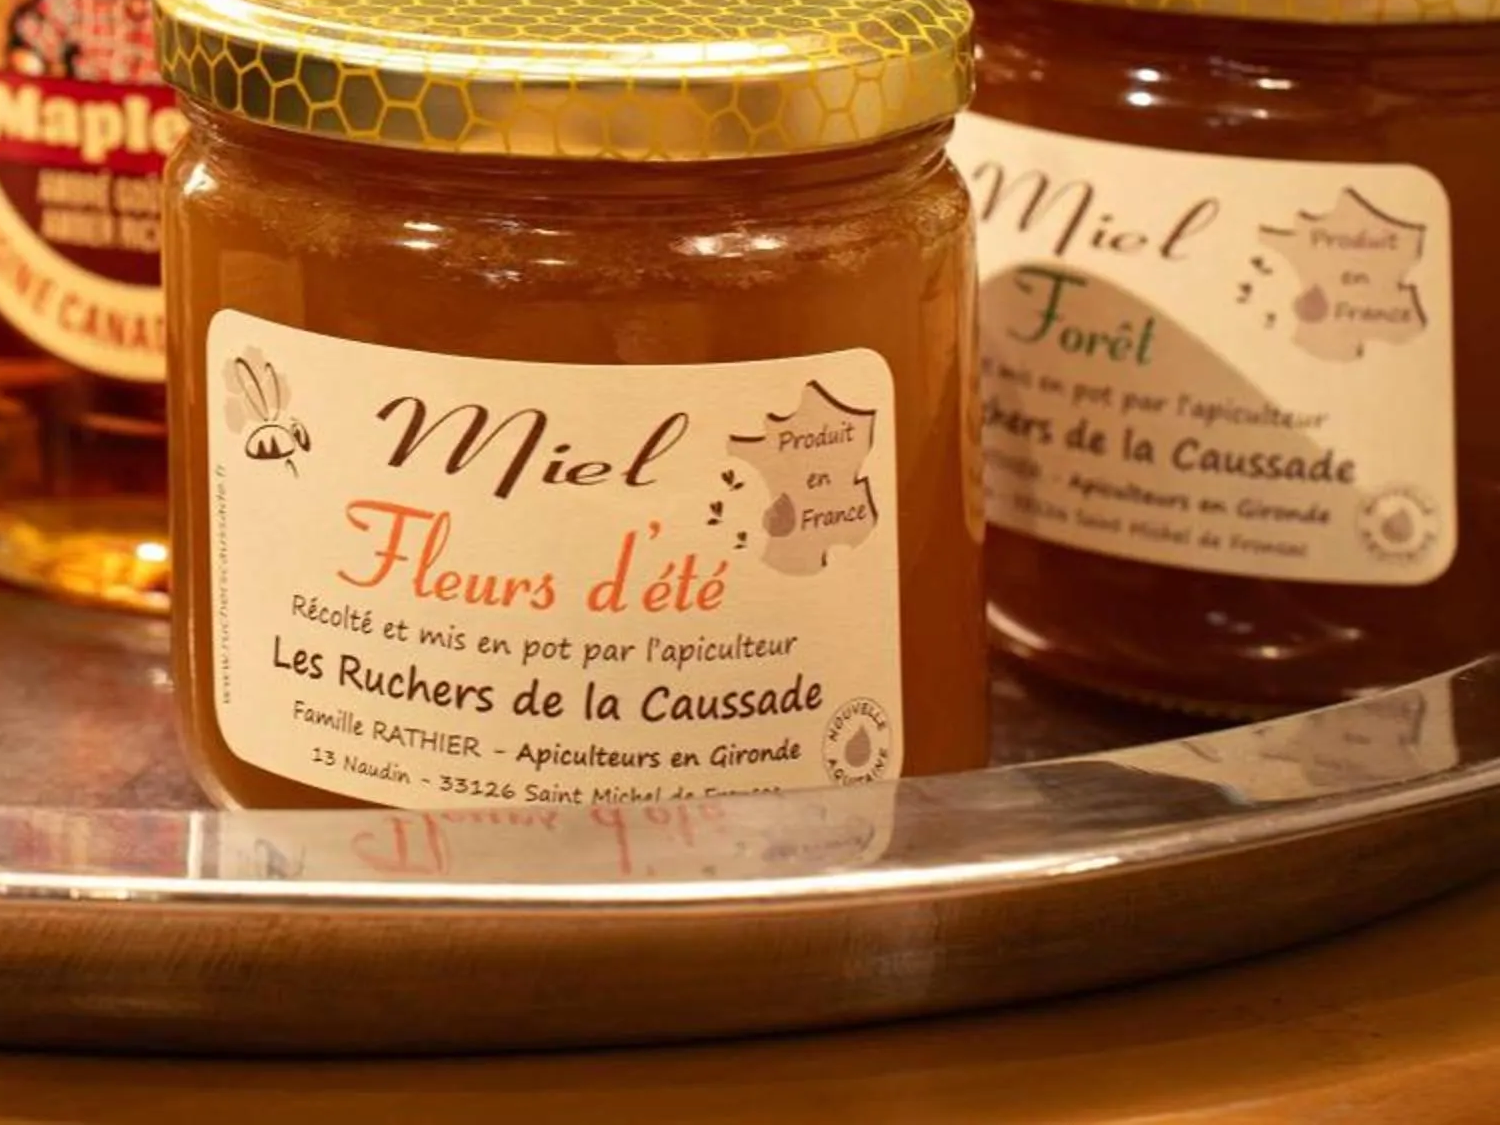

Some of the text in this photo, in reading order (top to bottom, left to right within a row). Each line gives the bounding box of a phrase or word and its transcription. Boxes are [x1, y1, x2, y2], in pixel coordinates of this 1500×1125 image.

[971, 161, 1220, 261] Miel
[1310, 228, 1398, 252] Produit
[1008, 264, 1157, 366] Forêt
[1334, 301, 1412, 324] France
[376, 396, 689, 499] Miel
[778, 421, 856, 451] Produit
[1065, 418, 1106, 456] de
[1123, 427, 1155, 464] la
[1171, 437, 1356, 484] Caussade
[806, 472, 831, 489] en
[801, 504, 867, 531] France
[337, 499, 729, 613] Fleurs d'été
[291, 594, 798, 672] Récolté et mis en pot par l'apiculteur
[273, 635, 823, 722] Les Ruchers de la Caussade
[292, 700, 364, 737] Famille
[372, 720, 481, 758] RATHIER
[515, 742, 661, 772] Apiculteurs
[670, 749, 700, 768] en
[710, 736, 802, 768] Gironde
[829, 701, 886, 742] NOUVELLE
[311, 747, 337, 766] 13
[343, 755, 411, 785] Naudin
[439, 775, 516, 800] 33126
[524, 783, 583, 805] Saint
